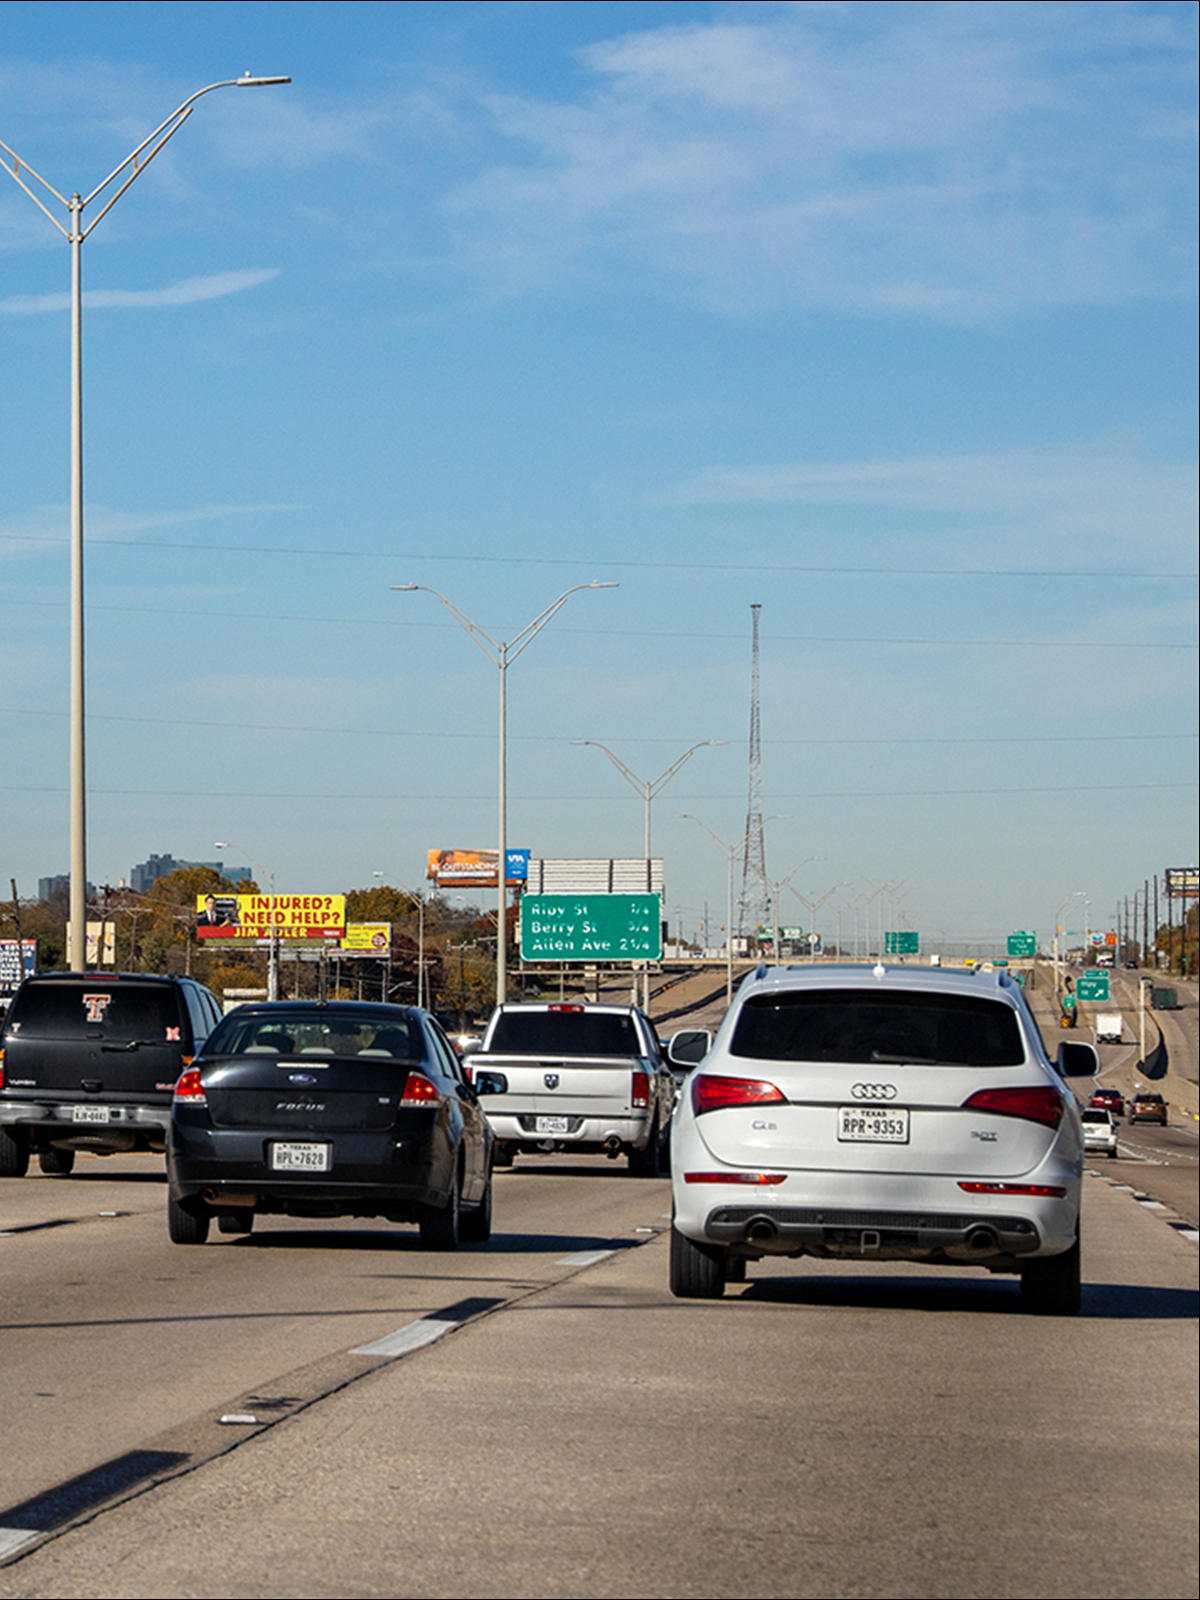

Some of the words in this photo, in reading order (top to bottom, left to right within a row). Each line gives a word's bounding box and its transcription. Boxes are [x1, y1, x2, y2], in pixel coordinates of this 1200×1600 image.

[251, 897, 333, 910] INJURED?
[573, 903, 588, 915] St
[243, 911, 286, 924] NEED
[291, 911, 341, 925] HELP?
[234, 927, 259, 937] JIM
[264, 927, 308, 937] ADLER
[531, 921, 574, 937] Berry
[582, 921, 597, 933] St
[582, 938, 611, 950] Ave
[276, 1102, 326, 1111] FOCUS
[861, 1109, 887, 1117] TEXAS
